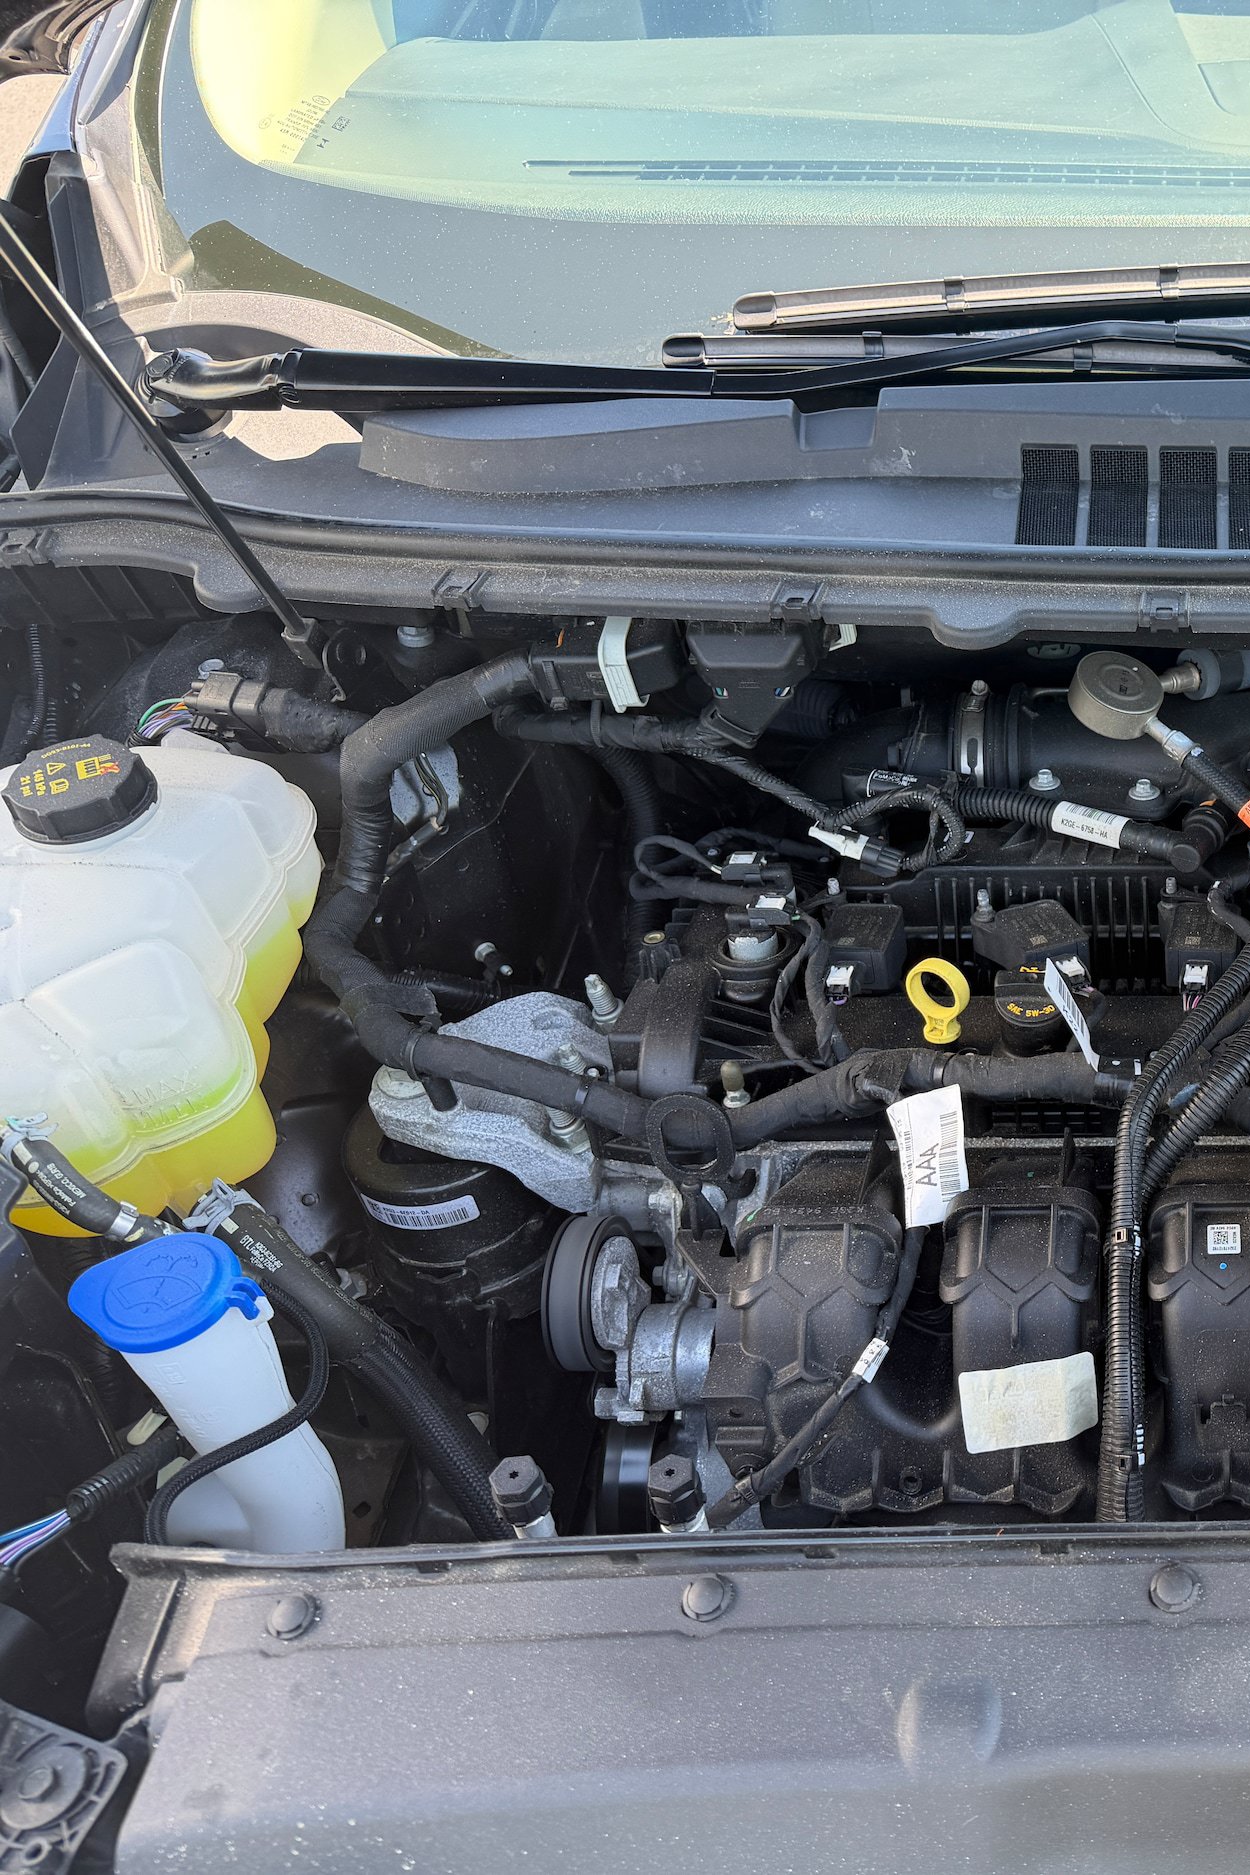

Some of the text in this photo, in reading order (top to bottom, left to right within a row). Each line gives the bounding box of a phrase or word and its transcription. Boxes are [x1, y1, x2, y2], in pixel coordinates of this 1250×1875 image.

[1007, 1003, 1056, 1017] SAE 5W-30
[915, 1143, 940, 1186] AAA
